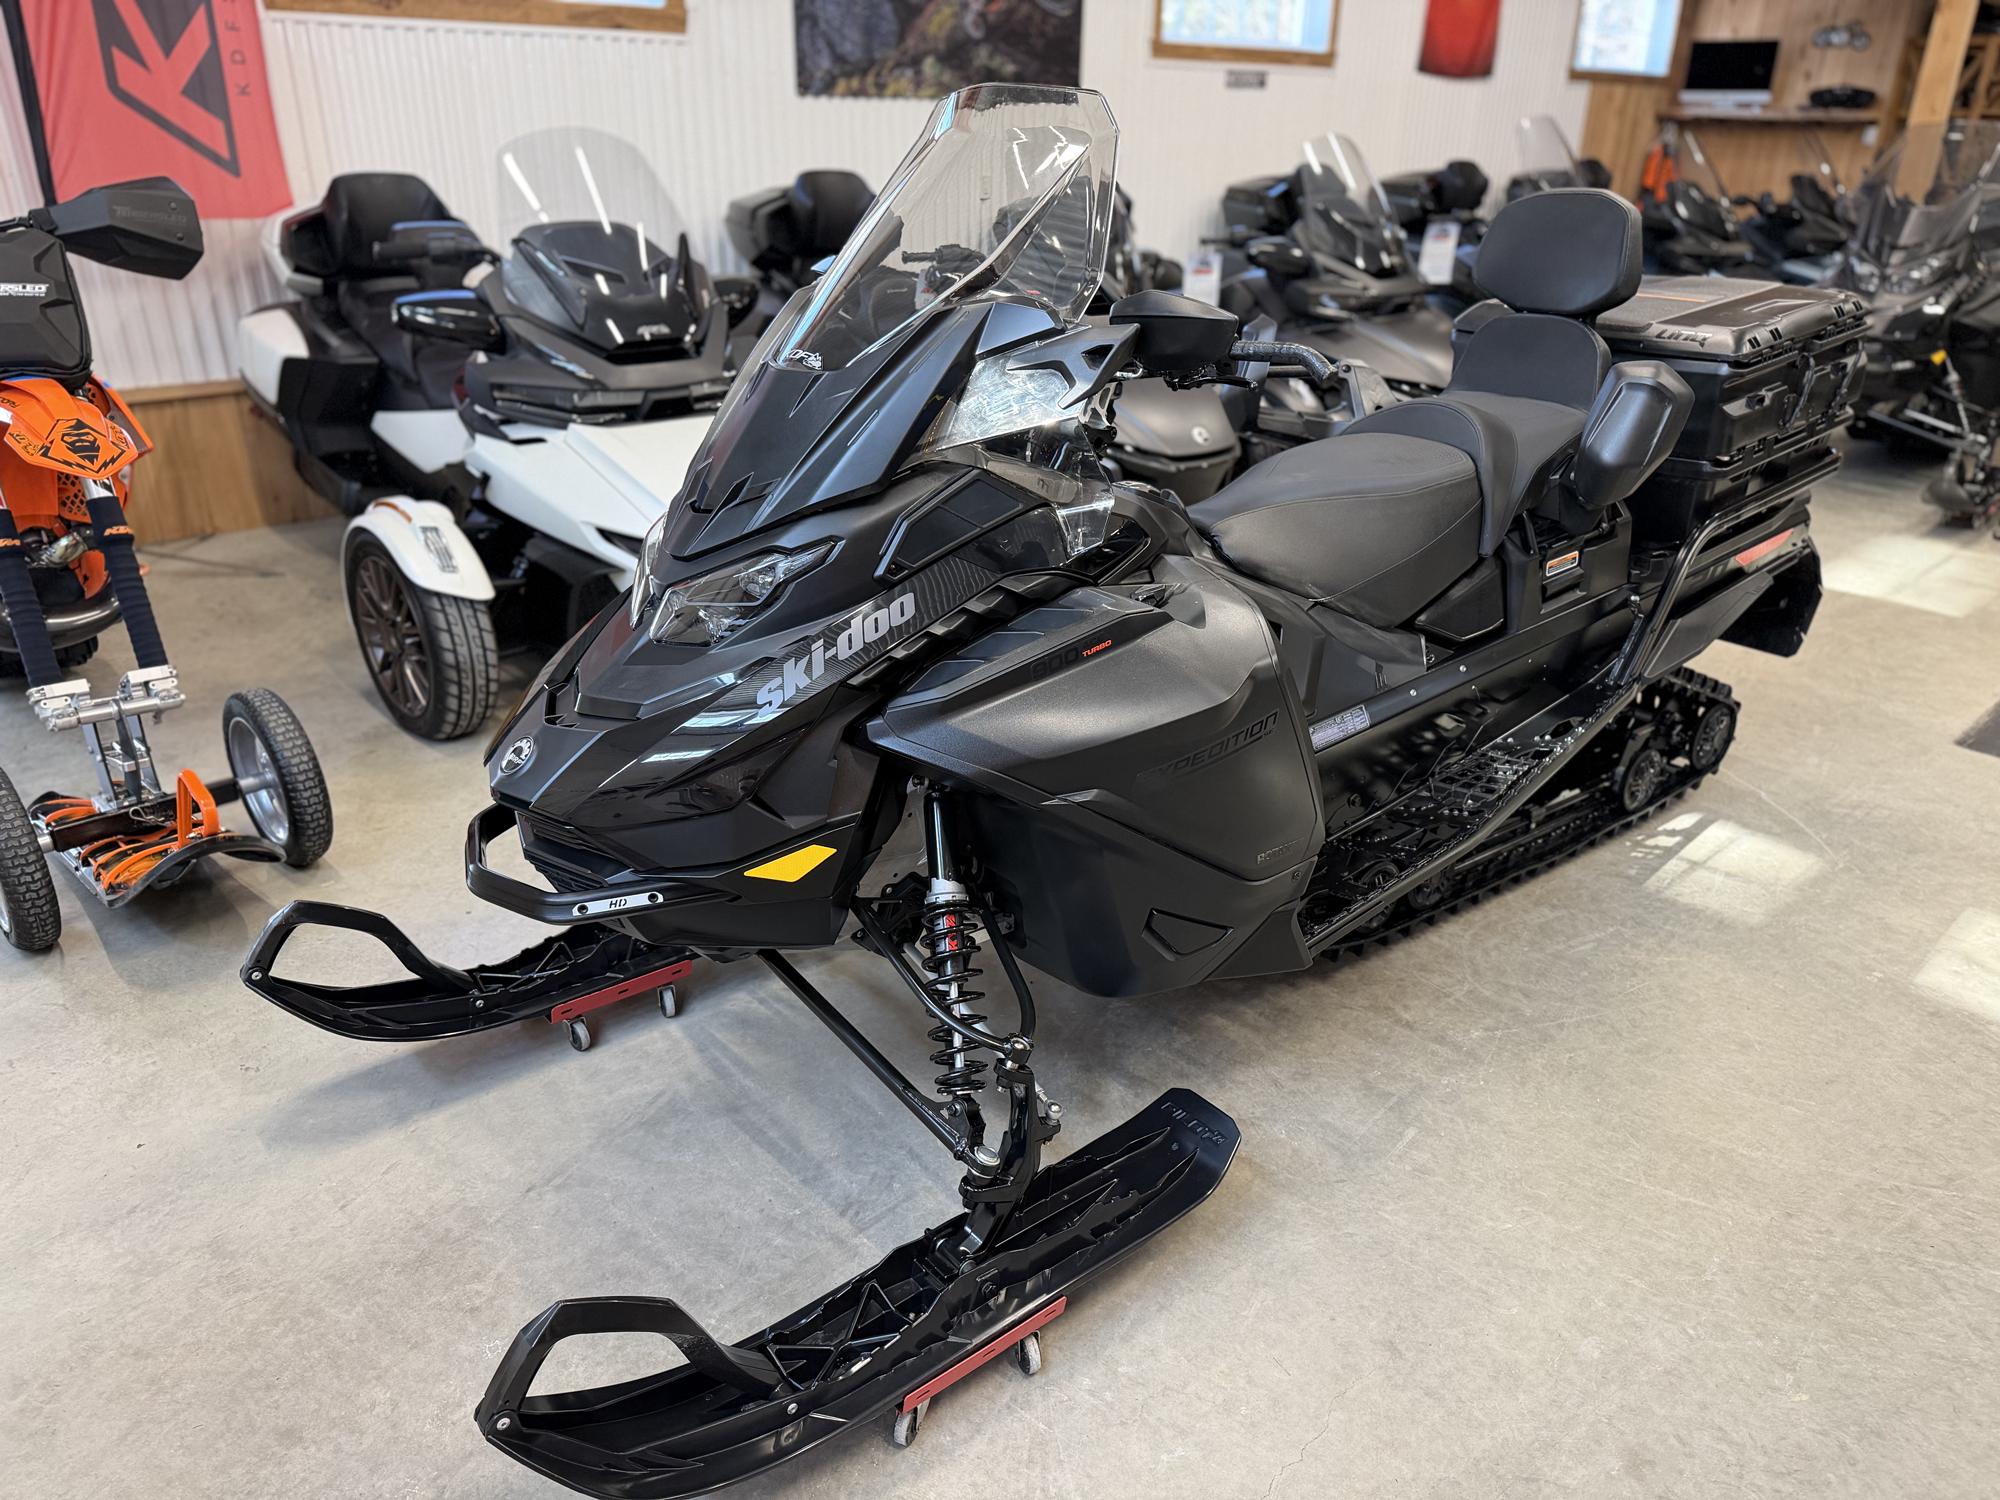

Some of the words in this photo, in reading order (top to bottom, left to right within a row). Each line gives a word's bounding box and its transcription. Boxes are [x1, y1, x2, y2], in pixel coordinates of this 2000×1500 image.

[221, 0, 252, 97] KDF
[1031, 646, 1080, 681] 900
[1082, 640, 1112, 657] TURBO
[1138, 710, 1278, 782] XPEDITION
[609, 898, 628, 909] HD
[1160, 1101, 1212, 1138] PILOT
